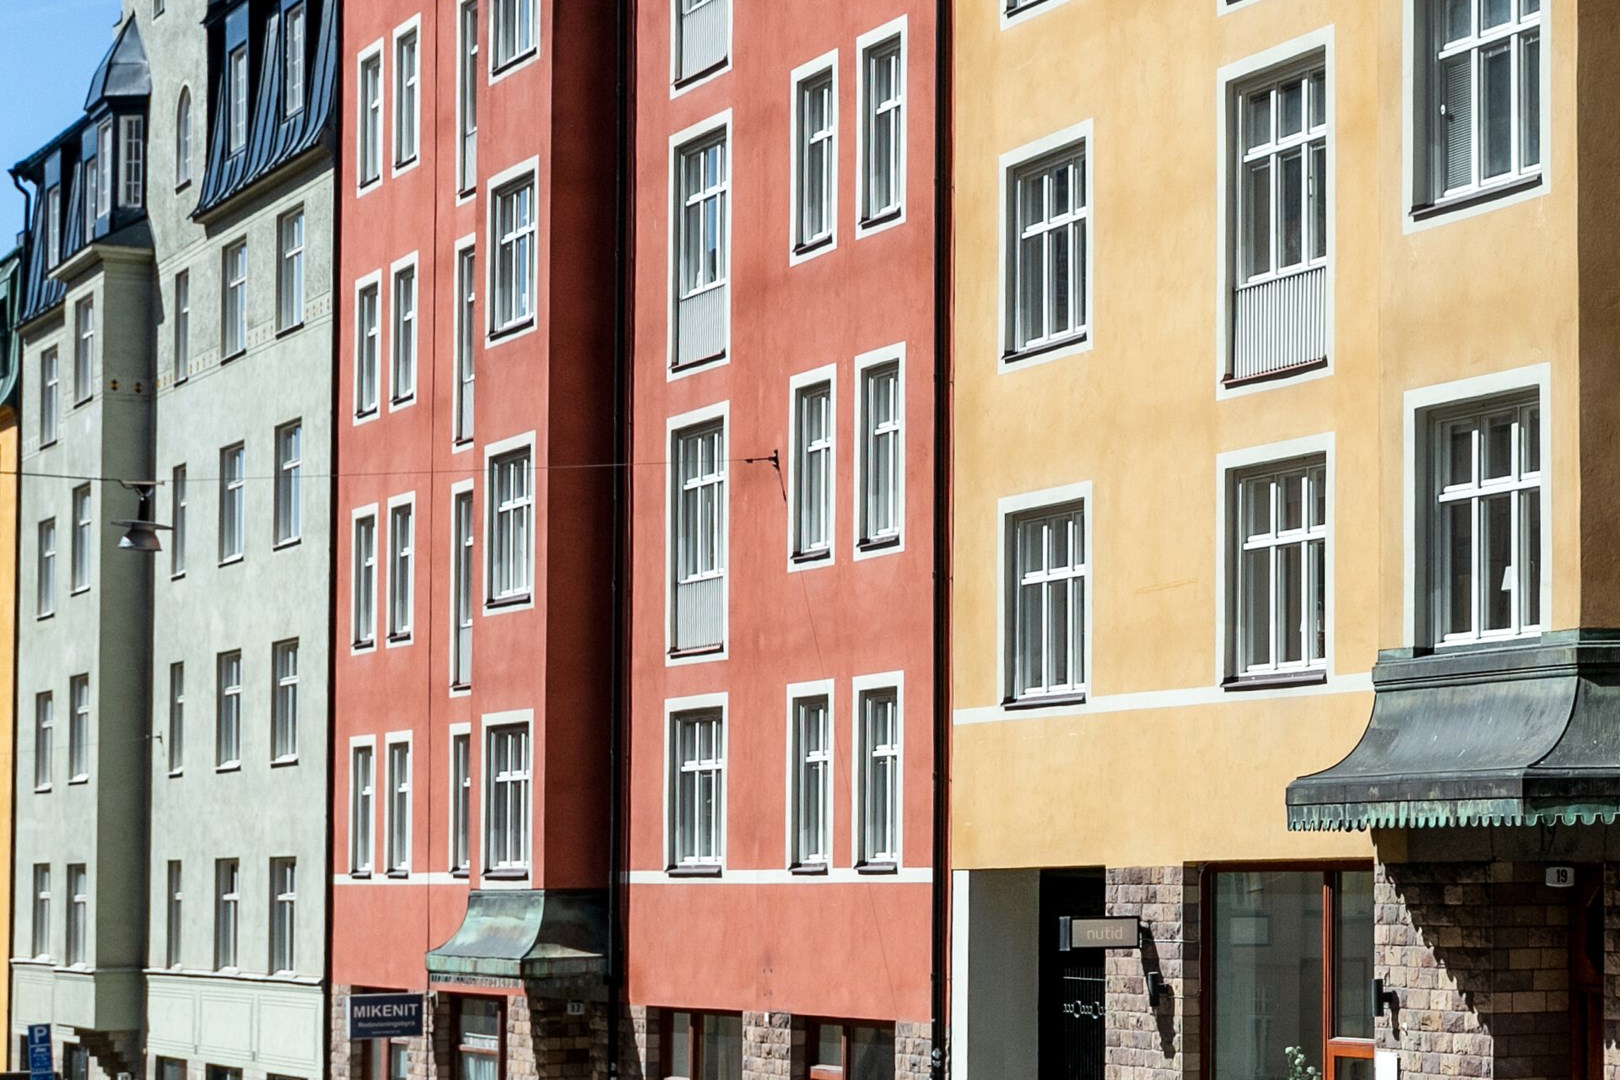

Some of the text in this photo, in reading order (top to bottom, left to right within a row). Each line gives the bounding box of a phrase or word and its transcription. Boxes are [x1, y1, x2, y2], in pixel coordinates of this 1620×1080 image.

[1556, 869, 1568, 883] 19
[1087, 927, 1123, 940] nutid
[353, 1004, 419, 1018] MIKENIT
[34, 1027, 48, 1043] P
